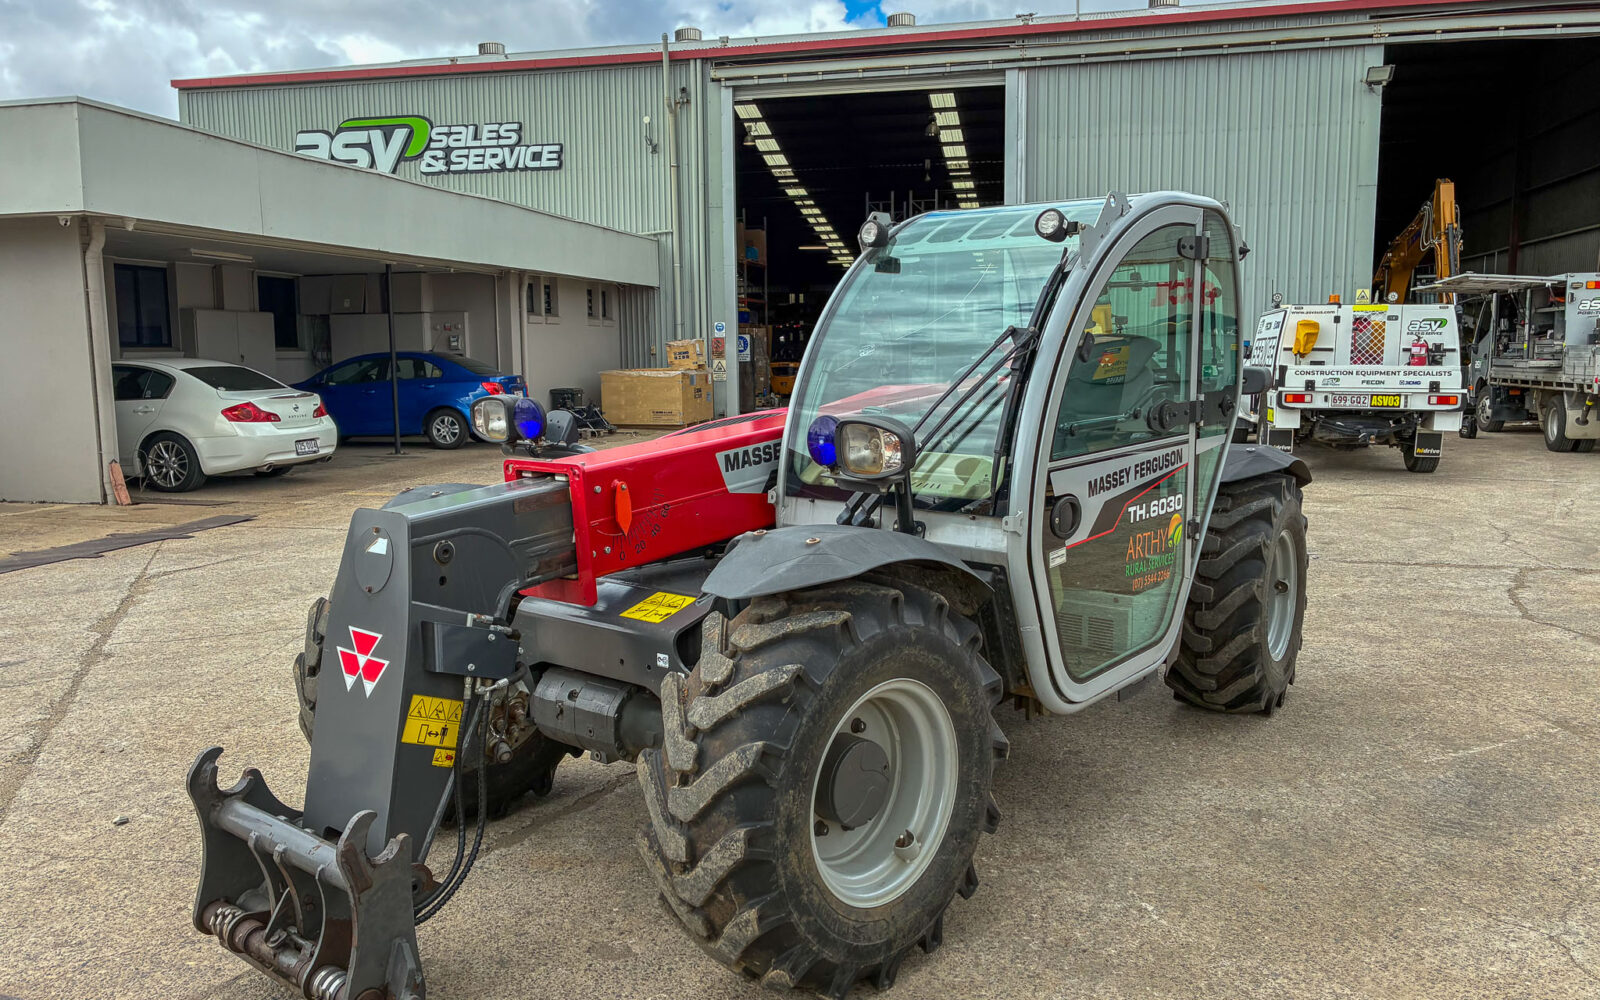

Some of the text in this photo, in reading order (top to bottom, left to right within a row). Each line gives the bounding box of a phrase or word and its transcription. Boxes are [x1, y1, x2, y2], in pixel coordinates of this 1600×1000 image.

[421, 145, 561, 173] & SERVICE
[1371, 395, 1400, 407] ASV03
[724, 442, 781, 473] MASSE
[1087, 448, 1183, 498] MASSEY FERGUSON
[660, 503, 671, 518] 60
[1127, 493, 1183, 523] TH.6030
[651, 523, 661, 537] 40
[620, 551, 626, 561] 0
[634, 540, 646, 554] 20
[1125, 527, 1169, 563] ARTHY
[1125, 552, 1175, 577] RURAL SERVICES
